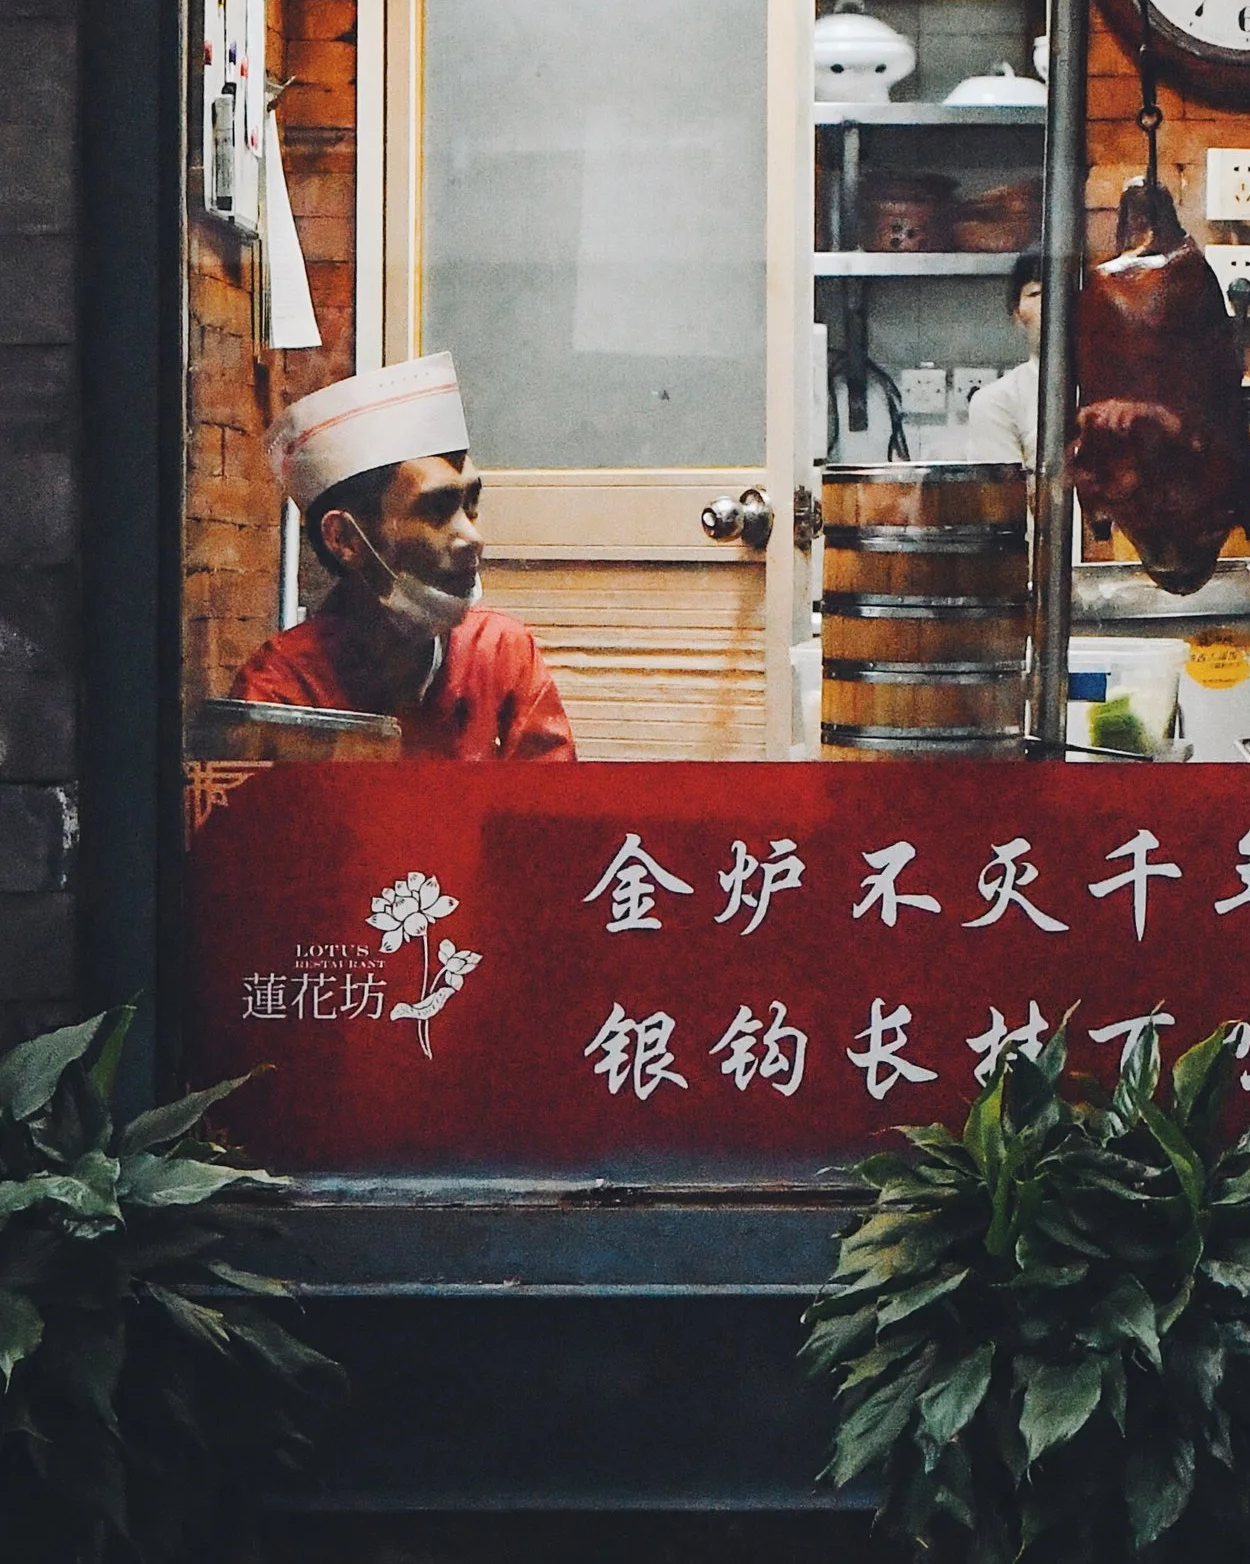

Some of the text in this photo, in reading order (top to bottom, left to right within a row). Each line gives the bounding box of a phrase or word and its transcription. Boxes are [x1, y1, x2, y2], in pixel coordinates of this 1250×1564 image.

[296, 944, 370, 958] LOTUS
[295, 959, 386, 969] RESTAURANT
[242, 972, 388, 1020] 蓮花坊
